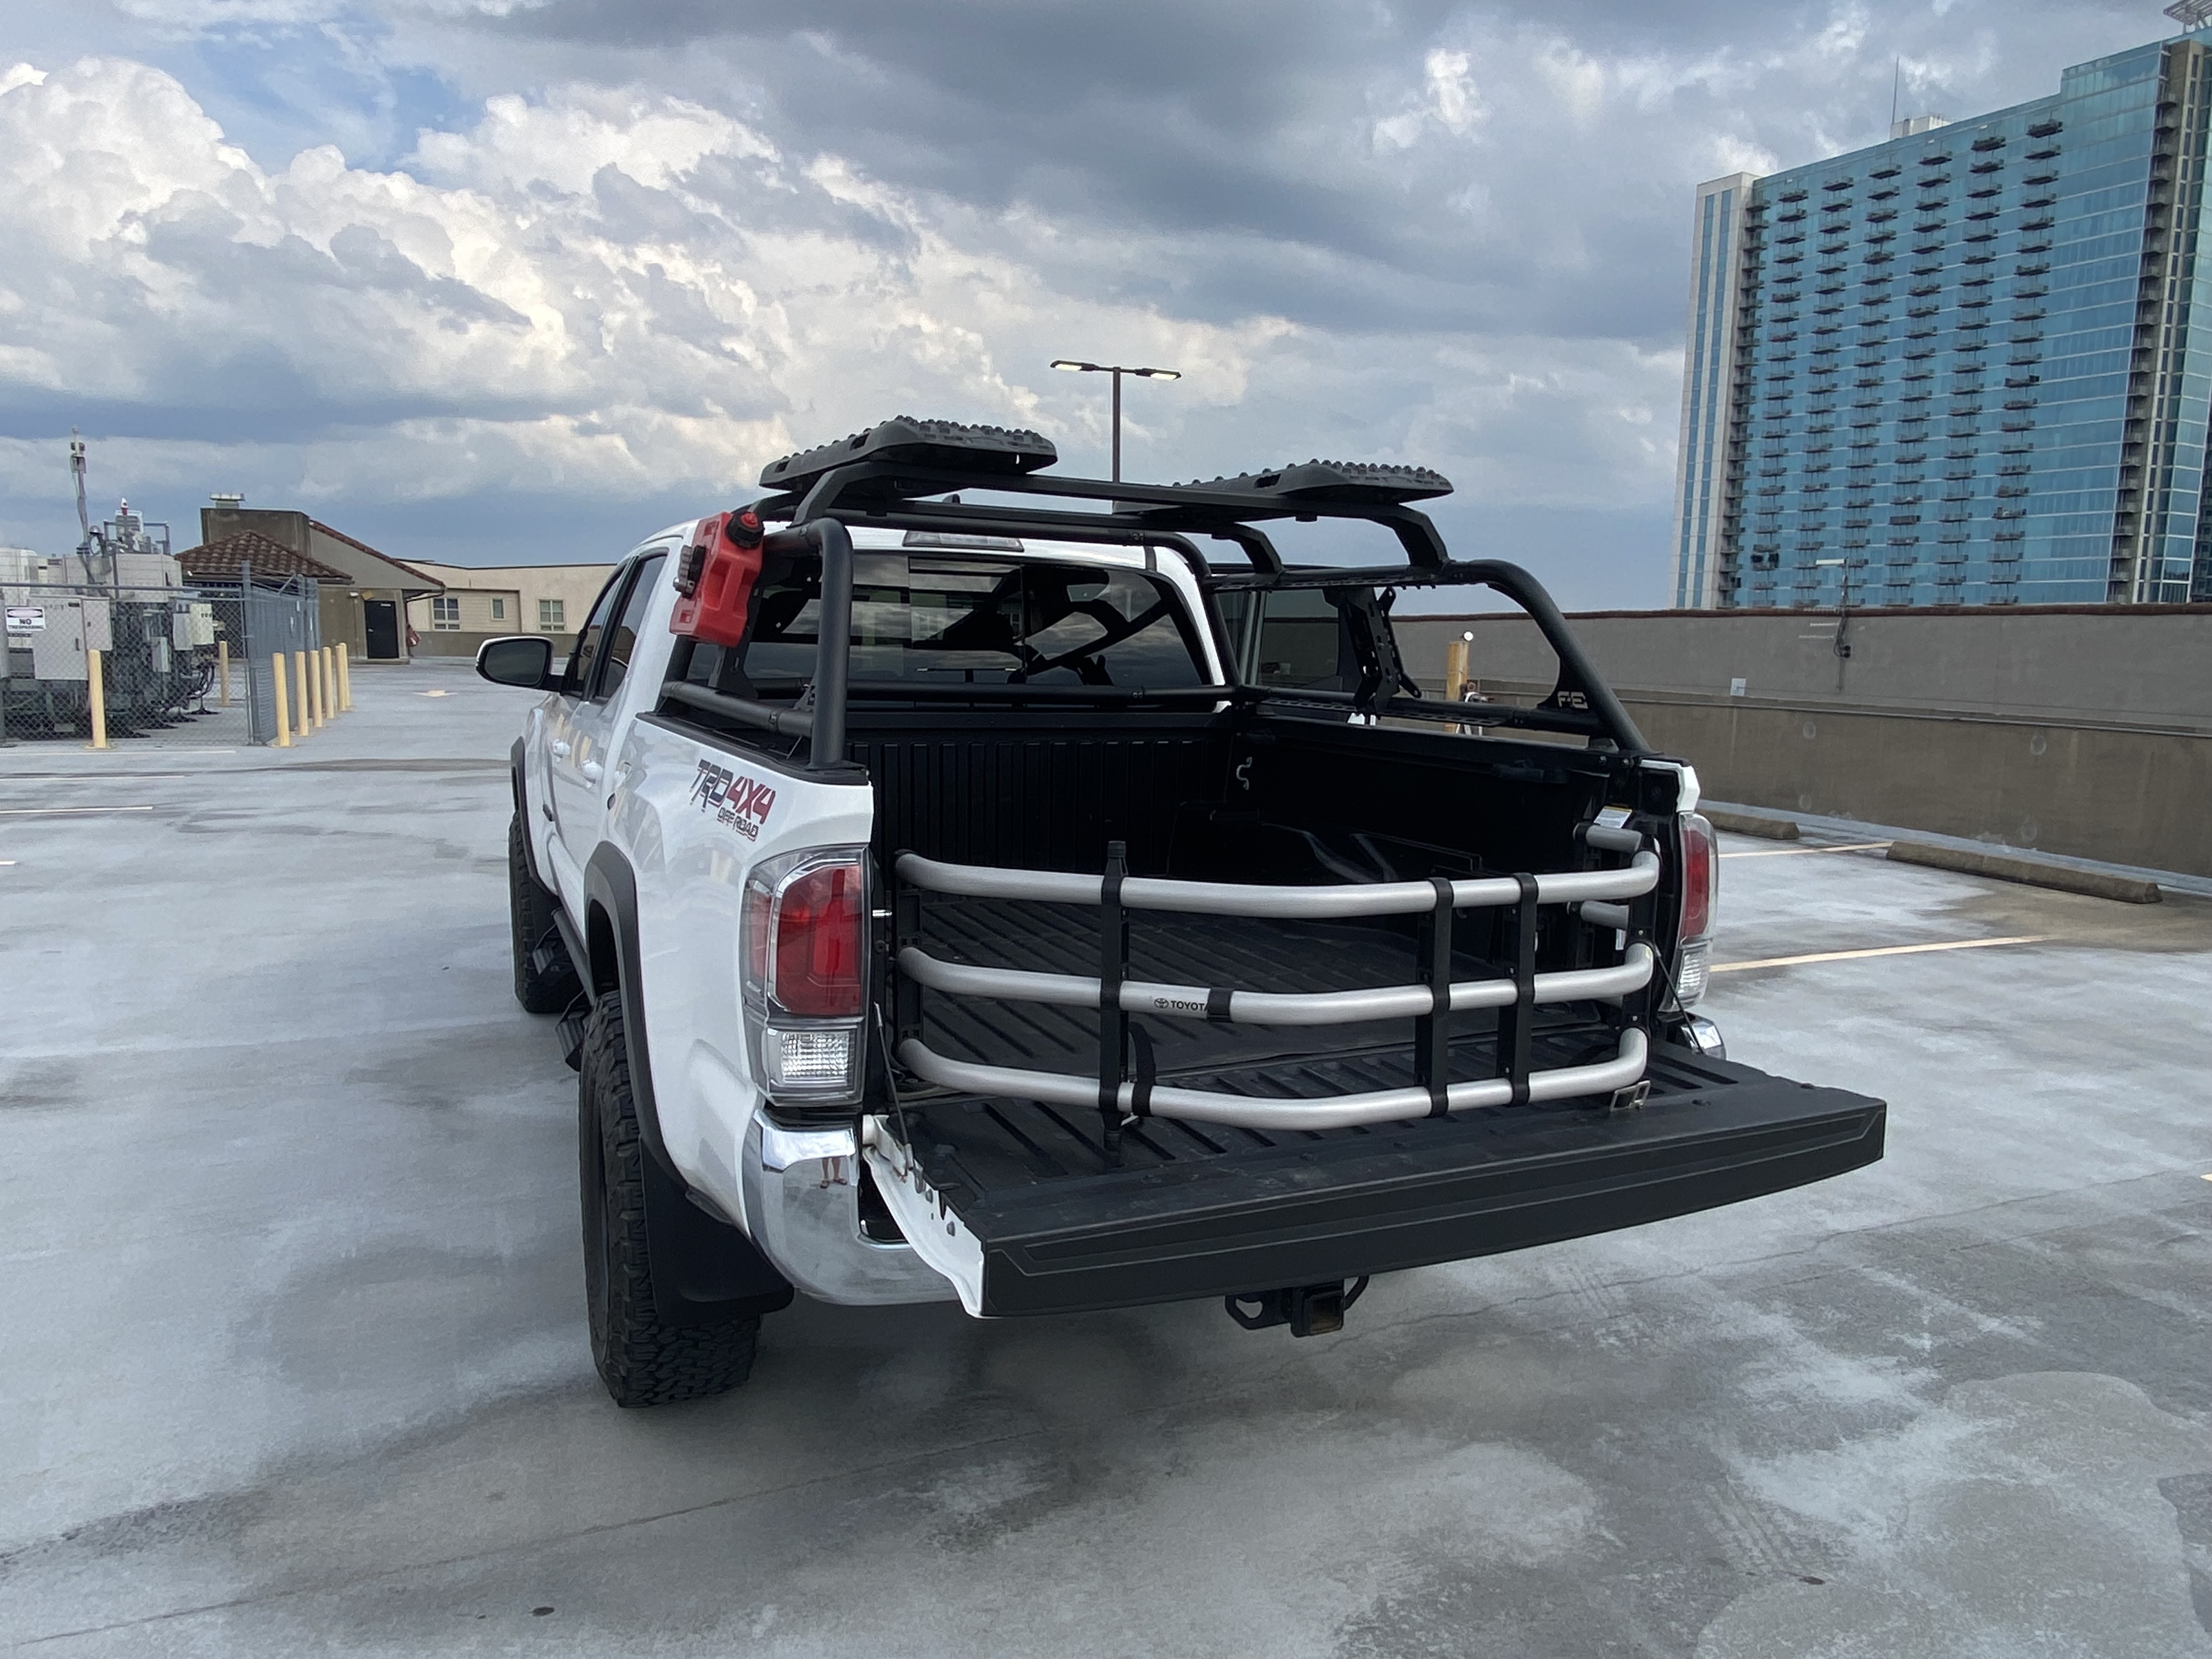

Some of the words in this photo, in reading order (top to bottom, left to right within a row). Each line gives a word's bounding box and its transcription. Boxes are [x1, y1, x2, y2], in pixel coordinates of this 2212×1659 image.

[689, 759, 734, 812] TRD
[717, 807, 736, 826] OFF
[733, 815, 759, 842] ROAD
